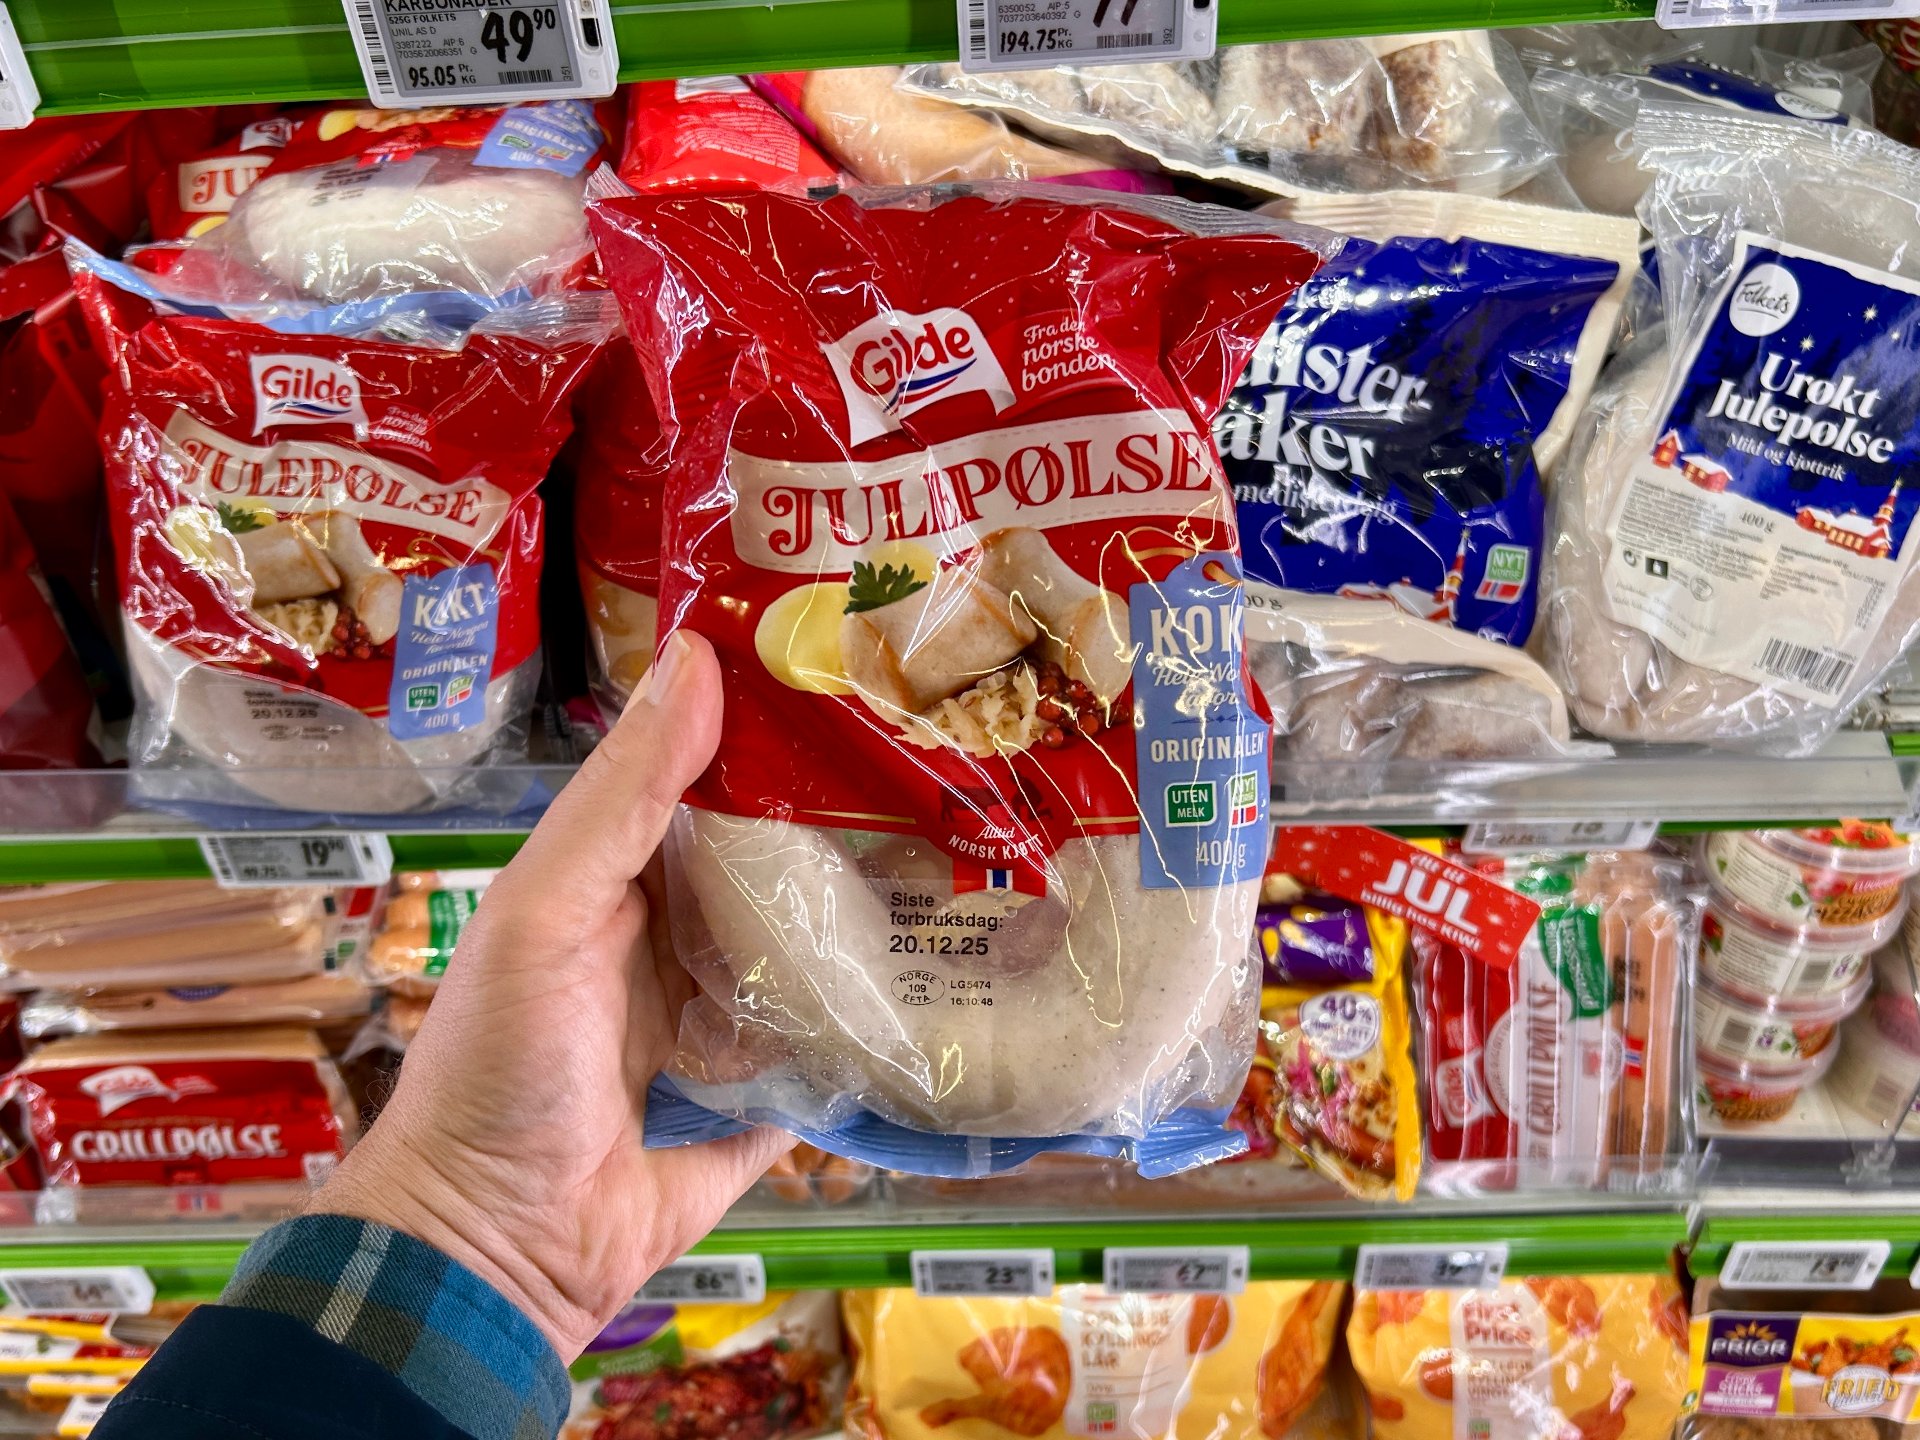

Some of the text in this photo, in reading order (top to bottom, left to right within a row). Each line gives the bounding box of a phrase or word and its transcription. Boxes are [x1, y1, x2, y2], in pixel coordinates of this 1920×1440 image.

[389, 13, 457, 24] 525G FOLKETS
[392, 26, 437, 36] UNIL AS D
[481, 9, 556, 64] 49 90
[1000, 27, 1072, 52] 194.75 Pr.
[1057, 40, 1073, 49] KG
[408, 63, 473, 88] 95.05 Pr.
[461, 75, 477, 84] KG
[1736, 280, 1790, 315] Folkets
[1023, 316, 1087, 346] Fra den
[849, 320, 974, 398] Gilde
[1022, 332, 1100, 363] norske
[1021, 354, 1117, 393] bonden
[260, 364, 353, 408] Gilde
[1763, 448, 1785, 466] og
[181, 437, 483, 527] JULEPØLSE
[761, 430, 1214, 557] JULEPØLSE
[1492, 551, 1525, 570] NYT
[1150, 604, 1244, 657] KOK
[1150, 731, 1263, 763] ORIGINALEN
[1172, 789, 1209, 804] UTEN
[1177, 806, 1206, 819] MELK
[975, 825, 1016, 840] Alltid
[301, 840, 330, 867] 19
[948, 833, 1044, 860] NORSK KJØTT
[1198, 840, 1231, 866] 400
[890, 892, 935, 907] Siste
[1372, 859, 1479, 935] JUL
[890, 910, 1004, 931] forbruksdag:
[1406, 906, 1438, 931] hos
[1440, 923, 1482, 952] KIWI
[889, 935, 989, 956] 20.12.25
[899, 971, 937, 985] NORGE
[908, 984, 927, 993] 109
[950, 980, 991, 990] LG5474
[902, 993, 931, 1003] EFTA
[950, 998, 993, 1007] 16:10:48
[1711, 1337, 1788, 1356] PRIOR
